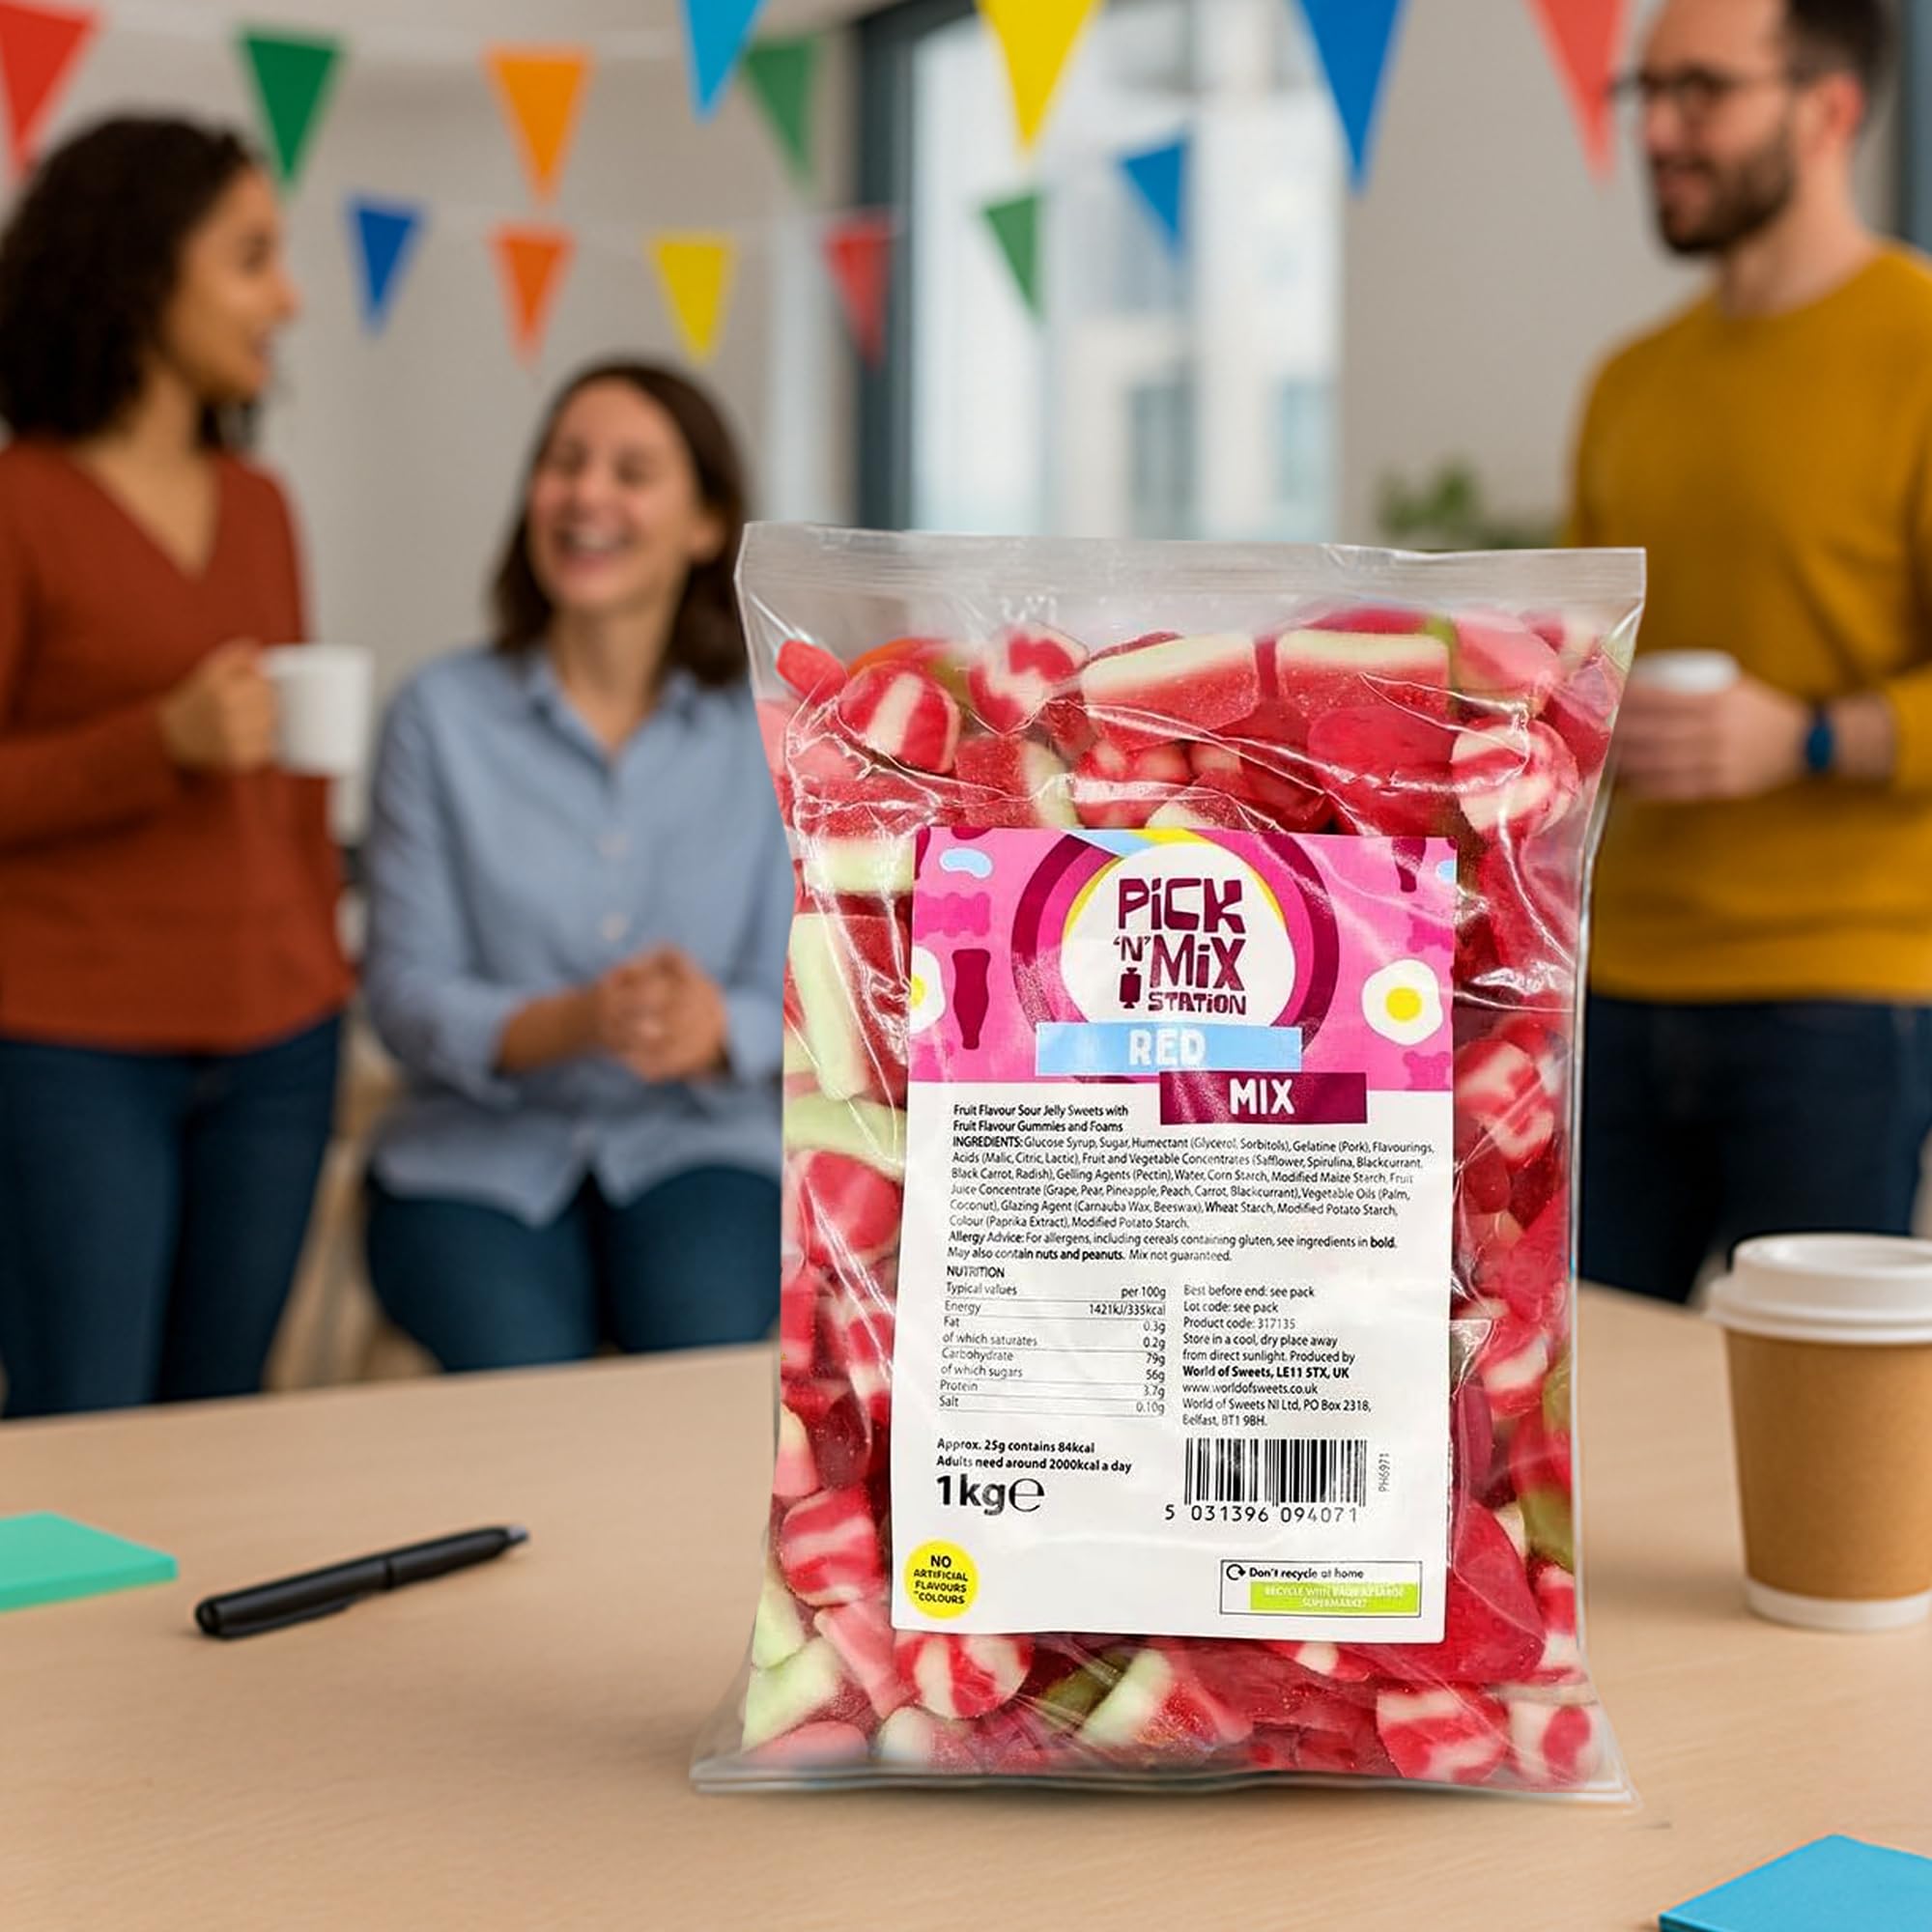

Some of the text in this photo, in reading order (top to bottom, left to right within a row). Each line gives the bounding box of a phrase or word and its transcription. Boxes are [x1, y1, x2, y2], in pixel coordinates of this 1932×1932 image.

[1128, 1029, 1206, 1065] RED
[1230, 1079, 1295, 1116] MIX
[953, 1104, 1128, 1119] Fruit Flavour Sour Jelly Sweets with
[953, 1121, 1123, 1132] Fruit Flavour Gummies and Foams
[1024, 1137, 1064, 1148] Glucose
[1131, 1137, 1188, 1148] Humectant
[1293, 1139, 1336, 1151] Gelatine
[952, 1152, 980, 1163] Acids
[1082, 1152, 1105, 1164] Fruit
[1107, 1152, 1127, 1164] and
[1128, 1152, 1179, 1167] Vegetable
[1181, 1153, 1250, 1165] Concentrates
[952, 1168, 979, 1179] Black
[1095, 1169, 1130, 1181] Agents
[1208, 1169, 1233, 1180] Corn
[1271, 1170, 1318, 1181] Modified
[1320, 1171, 1351, 1182] Maize
[979, 1184, 1041, 1195] Concentrate
[1301, 1187, 1354, 1201] Vegetable
[1356, 1188, 1376, 1199] Oils
[1001, 1200, 1039, 1213] Glazing
[1041, 1200, 1072, 1213] Agent
[1206, 1201, 1238, 1212] Wheat
[1326, 1203, 1361, 1214] Potato
[1071, 1216, 1117, 1228] Modified
[949, 1232, 984, 1245] Allergy
[1026, 1232, 1041, 1243] For
[1093, 1233, 1141, 1246] including
[1143, 1233, 1179, 1244] cereals
[1276, 1237, 1294, 1246] see
[1296, 1236, 1356, 1250] ingredients
[1357, 1236, 1368, 1247] in
[972, 1247, 993, 1259] also
[1036, 1248, 1059, 1259] nuts
[1060, 1248, 1080, 1260] and
[1128, 1249, 1149, 1260] Mix
[1150, 1249, 1168, 1261] not
[947, 1266, 1005, 1278] NUTRITION
[984, 1284, 1017, 1294] values
[1121, 1286, 1166, 1300] per 100g
[1208, 1285, 1242, 1296] before
[1290, 1286, 1315, 1299] pack
[945, 1301, 981, 1315] Energy
[1089, 1302, 1166, 1315] 1421kJ/335kcal
[1183, 1301, 1200, 1312] Lot
[1253, 1301, 1278, 1315] pack
[943, 1317, 959, 1327] Fat
[1143, 1321, 1166, 1334] 0.3g
[1183, 1317, 1224, 1328] Product
[1258, 1318, 1295, 1329] 317135
[942, 1332, 987, 1344] of which
[1143, 1336, 1166, 1350] 0.2g
[1183, 1333, 1209, 1344] Store
[1212, 1333, 1222, 1345] in
[1224, 1336, 1231, 1345] a
[1260, 1334, 1278, 1348] dry
[1280, 1334, 1308, 1348] place
[1310, 1337, 1338, 1349] away
[942, 1349, 1014, 1363] Carbohydrate
[1146, 1353, 1165, 1367] 79g
[1182, 1350, 1208, 1360] from
[1209, 1350, 1240, 1361] direct
[1290, 1350, 1340, 1362] Produced
[1342, 1351, 1355, 1365] by
[941, 1364, 1023, 1379] of which sugars
[1146, 1369, 1165, 1382] 56g
[1182, 1365, 1215, 1377] World
[1217, 1366, 1230, 1377] of
[1276, 1367, 1302, 1378] LE11
[1333, 1367, 1350, 1378] UK
[940, 1380, 979, 1392] Protein
[1144, 1385, 1165, 1399] 3.7g
[939, 1396, 958, 1406] Salt
[1136, 1401, 1165, 1414] 0.10g
[1229, 1399, 1265, 1409] Sweets
[1267, 1399, 1280, 1410] NI
[1303, 1400, 1319, 1410] PO
[1321, 1400, 1341, 1410] Box
[984, 1439, 1005, 1454] 25g
[1008, 1440, 1056, 1452] contains
[1058, 1441, 1094, 1453] 84kcal
[936, 1456, 1131, 1474] Adults need around 2000kcal a day
[1164, 1505, 1357, 1522] 5 031396 094071
[930, 1555, 952, 1569] NO
[913, 1569, 969, 1581] ARTIFICIAL
[1249, 1568, 1364, 1580] Don't recycle at home
[915, 1581, 967, 1593] FLAVOURS
[919, 1593, 965, 1604] COLOURS
